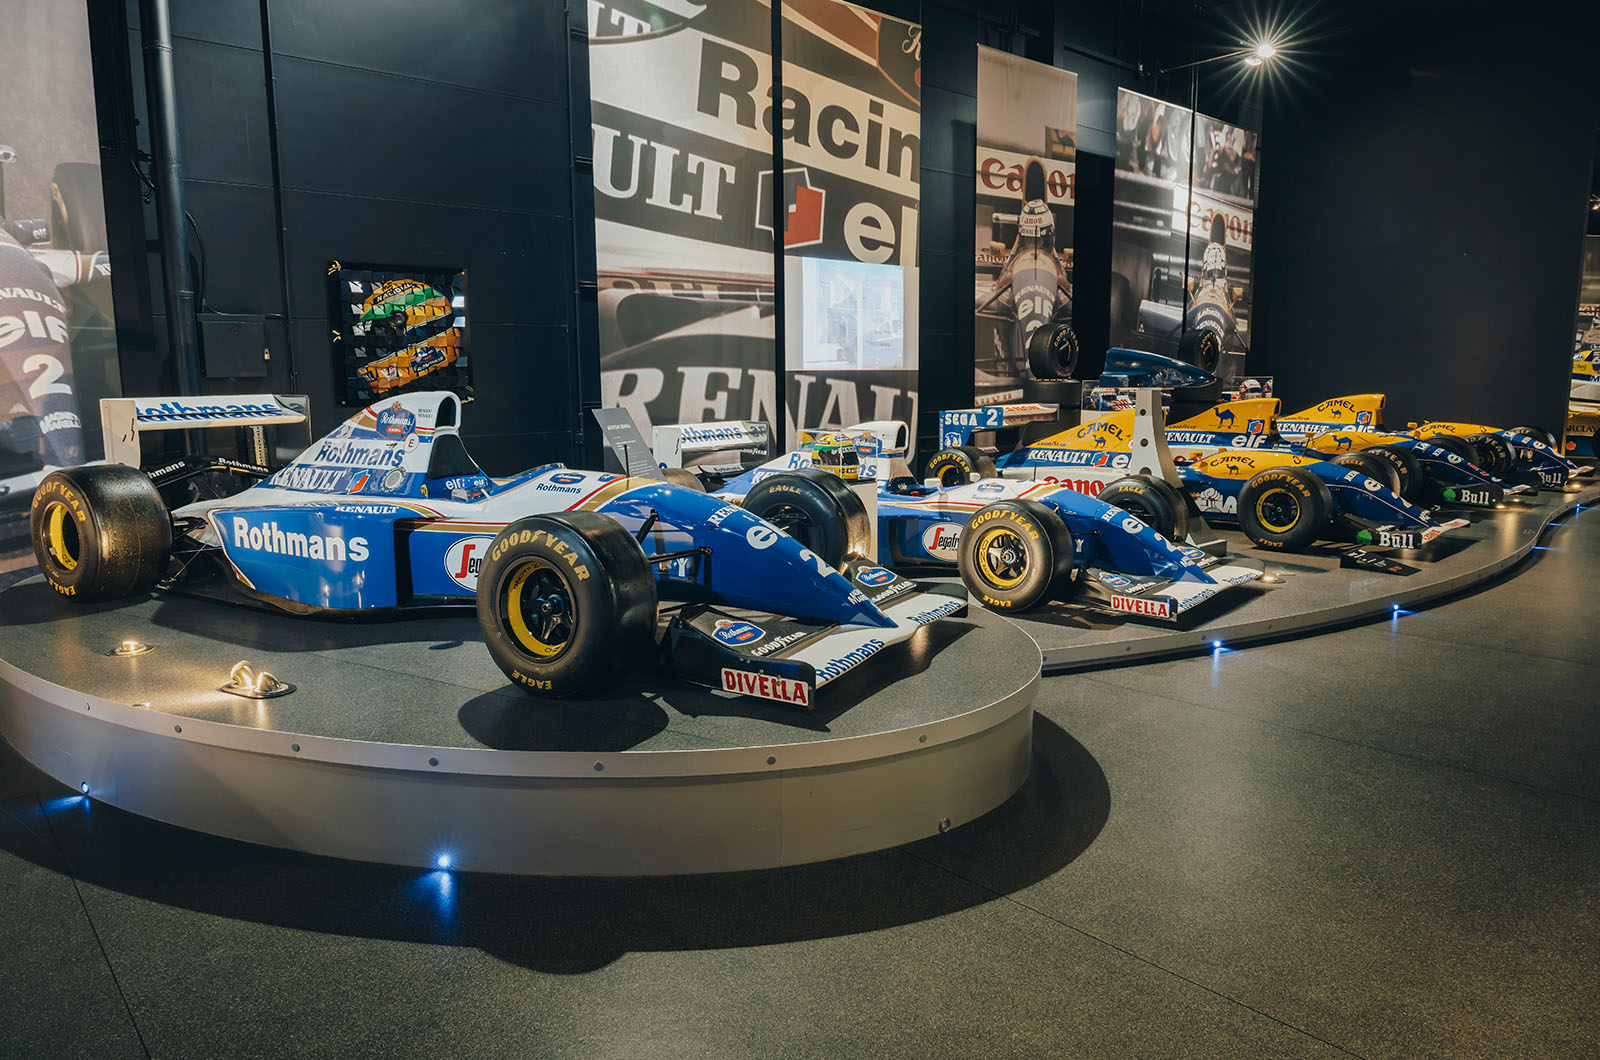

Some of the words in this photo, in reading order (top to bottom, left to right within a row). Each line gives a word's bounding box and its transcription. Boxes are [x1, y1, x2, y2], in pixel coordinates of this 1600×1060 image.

[33, 227, 48, 239] elf
[1018, 296, 1054, 321] elf
[22, 354, 73, 400] 2
[1317, 399, 1355, 413] CAMEL
[944, 413, 978, 426] SEGA
[986, 408, 998, 426] 2
[1077, 422, 1124, 441] CAMEL
[1165, 432, 1215, 443] ENAULT
[1421, 424, 1456, 434] CAMEL
[408, 439, 415, 447] E
[1231, 435, 1267, 448] elf
[314, 441, 406, 468] Rothmans
[929, 453, 970, 473] GOODYEAR
[1028, 449, 1091, 464] RENAULT
[1210, 456, 1256, 468] CAMEL
[146, 460, 187, 478] hmans
[218, 457, 270, 473] Rothmans
[269, 467, 346, 491] RENAULT
[445, 478, 461, 490] elf
[1251, 473, 1311, 497] GOODYEAR
[536, 483, 582, 494] Rothmans
[769, 484, 801, 494] EAGLE
[1119, 485, 1145, 495] EAGLE
[1460, 489, 1489, 505] Bull
[33, 481, 86, 522] GOODYEAR
[335, 506, 400, 515] RENAULT
[971, 510, 1039, 541] GOODYEAR
[233, 516, 370, 562] Rothmans
[1258, 537, 1284, 548] EAGLE
[1379, 531, 1414, 549] Bull
[492, 529, 590, 582] GOODYEAR
[800, 548, 838, 578] 2
[49, 577, 77, 596] EAGLE
[983, 594, 1012, 607] EAGLE
[1112, 596, 1168, 617] DIVELLA
[750, 631, 807, 656] GOODYEAR
[816, 637, 885, 682] Rothmans
[512, 669, 552, 690] EAGLE
[723, 670, 808, 704] DIVELLA
